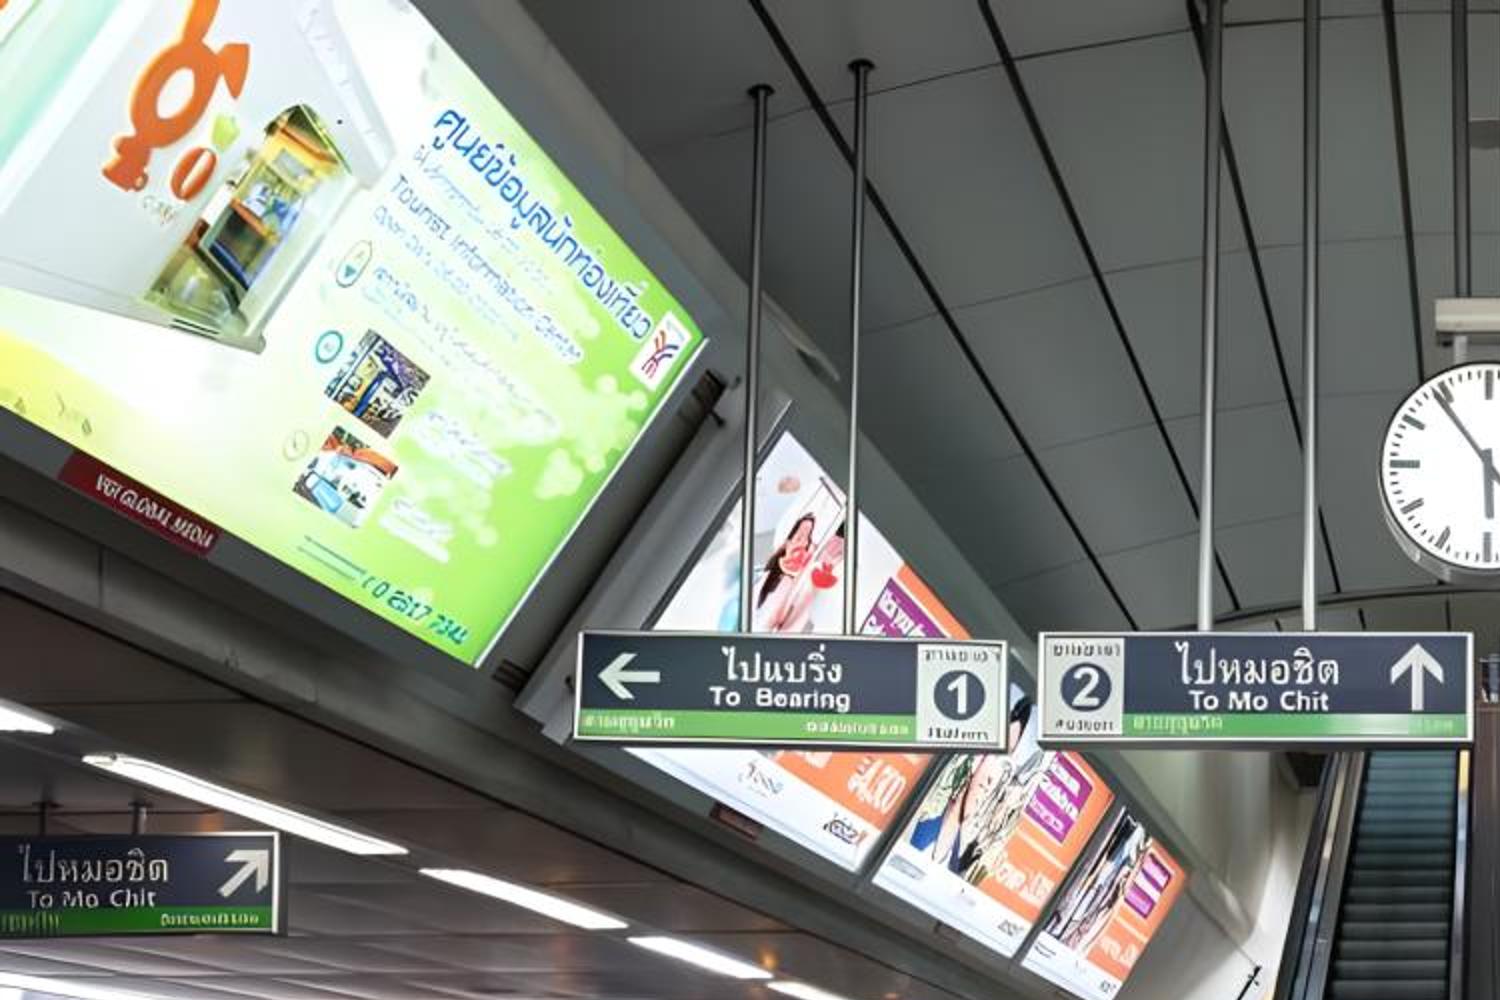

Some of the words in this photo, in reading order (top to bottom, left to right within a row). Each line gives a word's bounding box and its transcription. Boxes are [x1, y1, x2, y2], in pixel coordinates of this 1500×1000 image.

[721, 643, 843, 684] ไปแบริ่ง
[1174, 640, 1340, 686] ไปหมอชิต
[709, 686, 741, 707] To
[755, 688, 851, 713] Bearing
[946, 673, 968, 715] 1
[1071, 667, 1100, 707] 2
[1188, 689, 1220, 711] To
[1228, 690, 1269, 711] Mo
[1279, 690, 1329, 711] Chit
[19, 844, 169, 883] ไปหมอชิต
[29, 891, 53, 909] To
[62, 890, 99, 909] Mo
[109, 888, 157, 909] Chit
